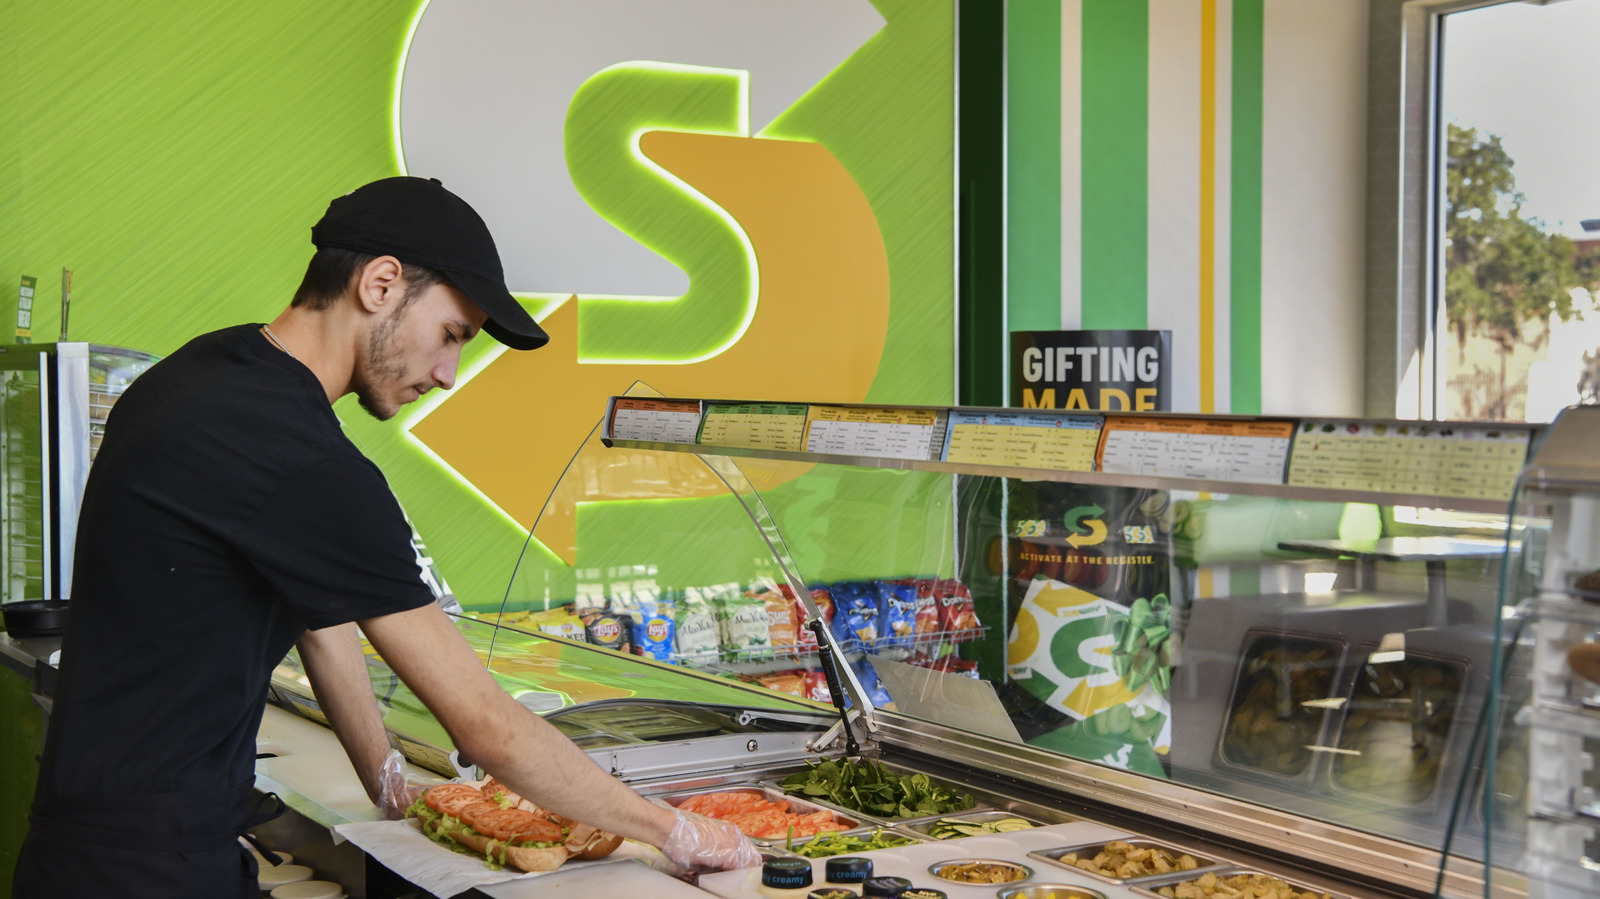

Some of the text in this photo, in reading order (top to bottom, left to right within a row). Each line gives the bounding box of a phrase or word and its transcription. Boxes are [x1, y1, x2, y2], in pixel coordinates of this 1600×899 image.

[1022, 346, 1159, 383] GIFTING
[1022, 388, 1158, 411] MADE
[1020, 552, 1063, 563] ACTIVATE
[1066, 555, 1078, 564] AT
[1083, 556, 1102, 565] THE
[594, 623, 619, 637] Lay's
[648, 622, 669, 637] Lay's
[771, 875, 804, 885] creamy
[836, 870, 868, 880] creamy
